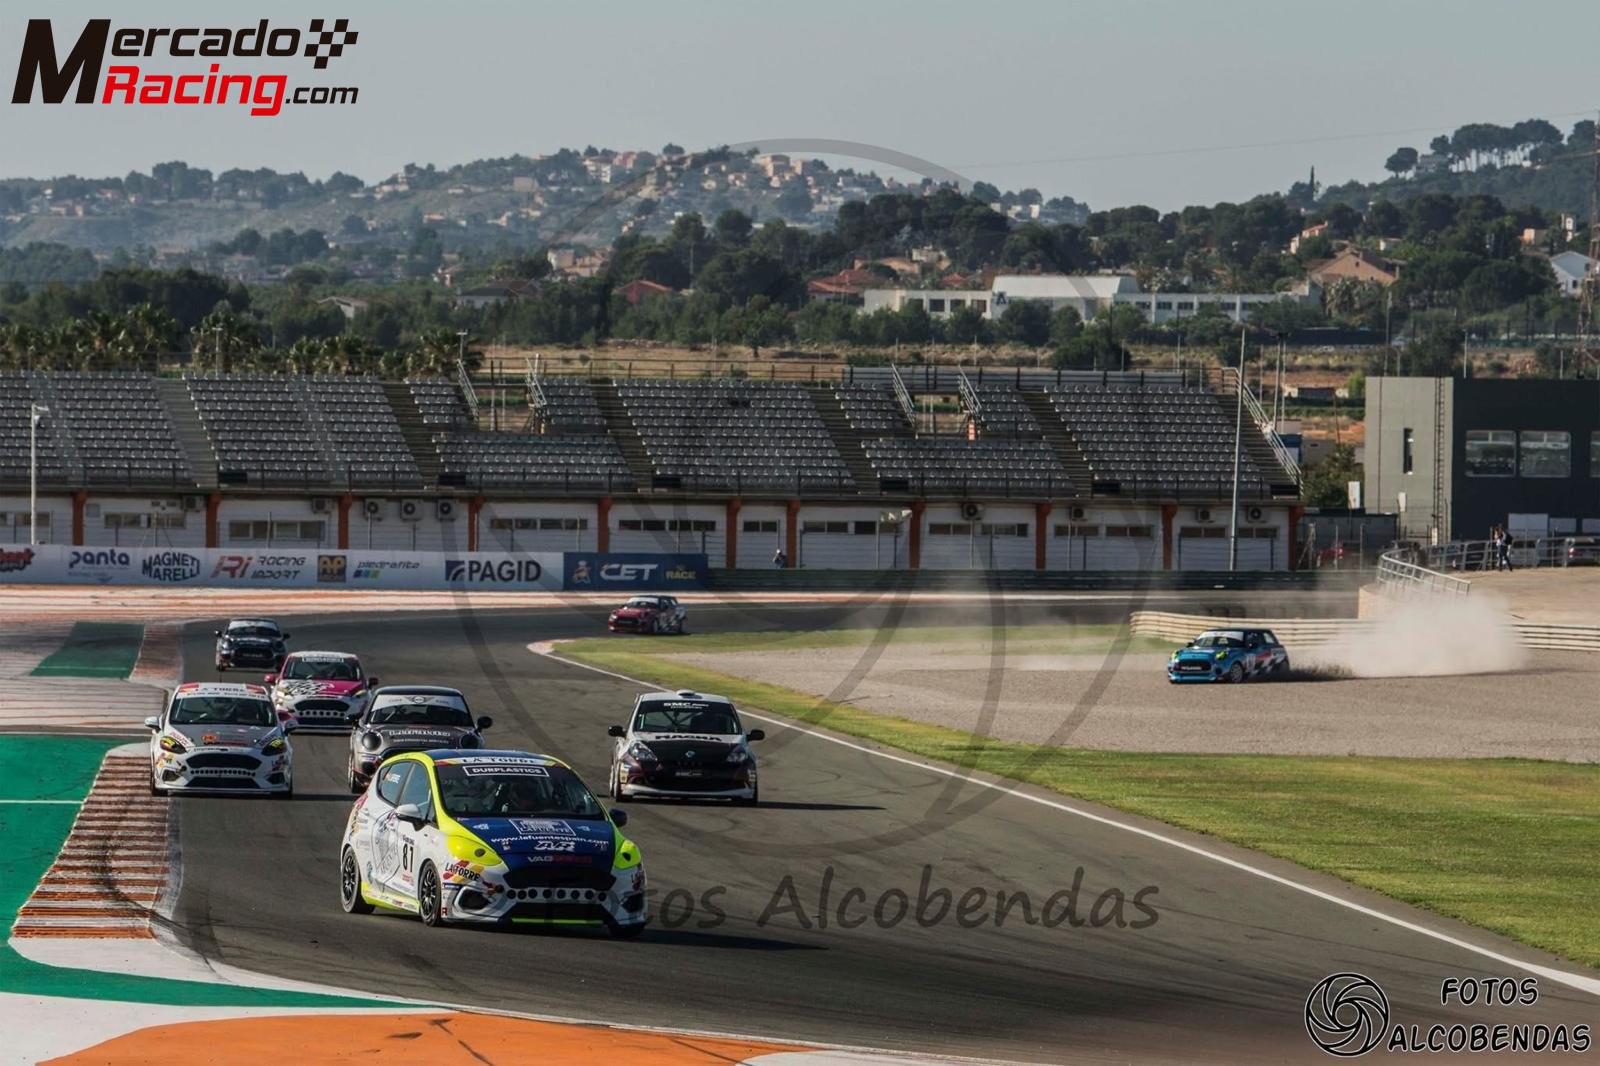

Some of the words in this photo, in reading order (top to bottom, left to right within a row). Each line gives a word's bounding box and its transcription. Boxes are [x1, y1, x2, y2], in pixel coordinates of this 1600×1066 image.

[69, 549, 130, 568] panta
[469, 560, 542, 582] PAGID
[600, 563, 659, 581] CET
[666, 570, 697, 580] RACE
[471, 765, 542, 776] DURPLASTICS
